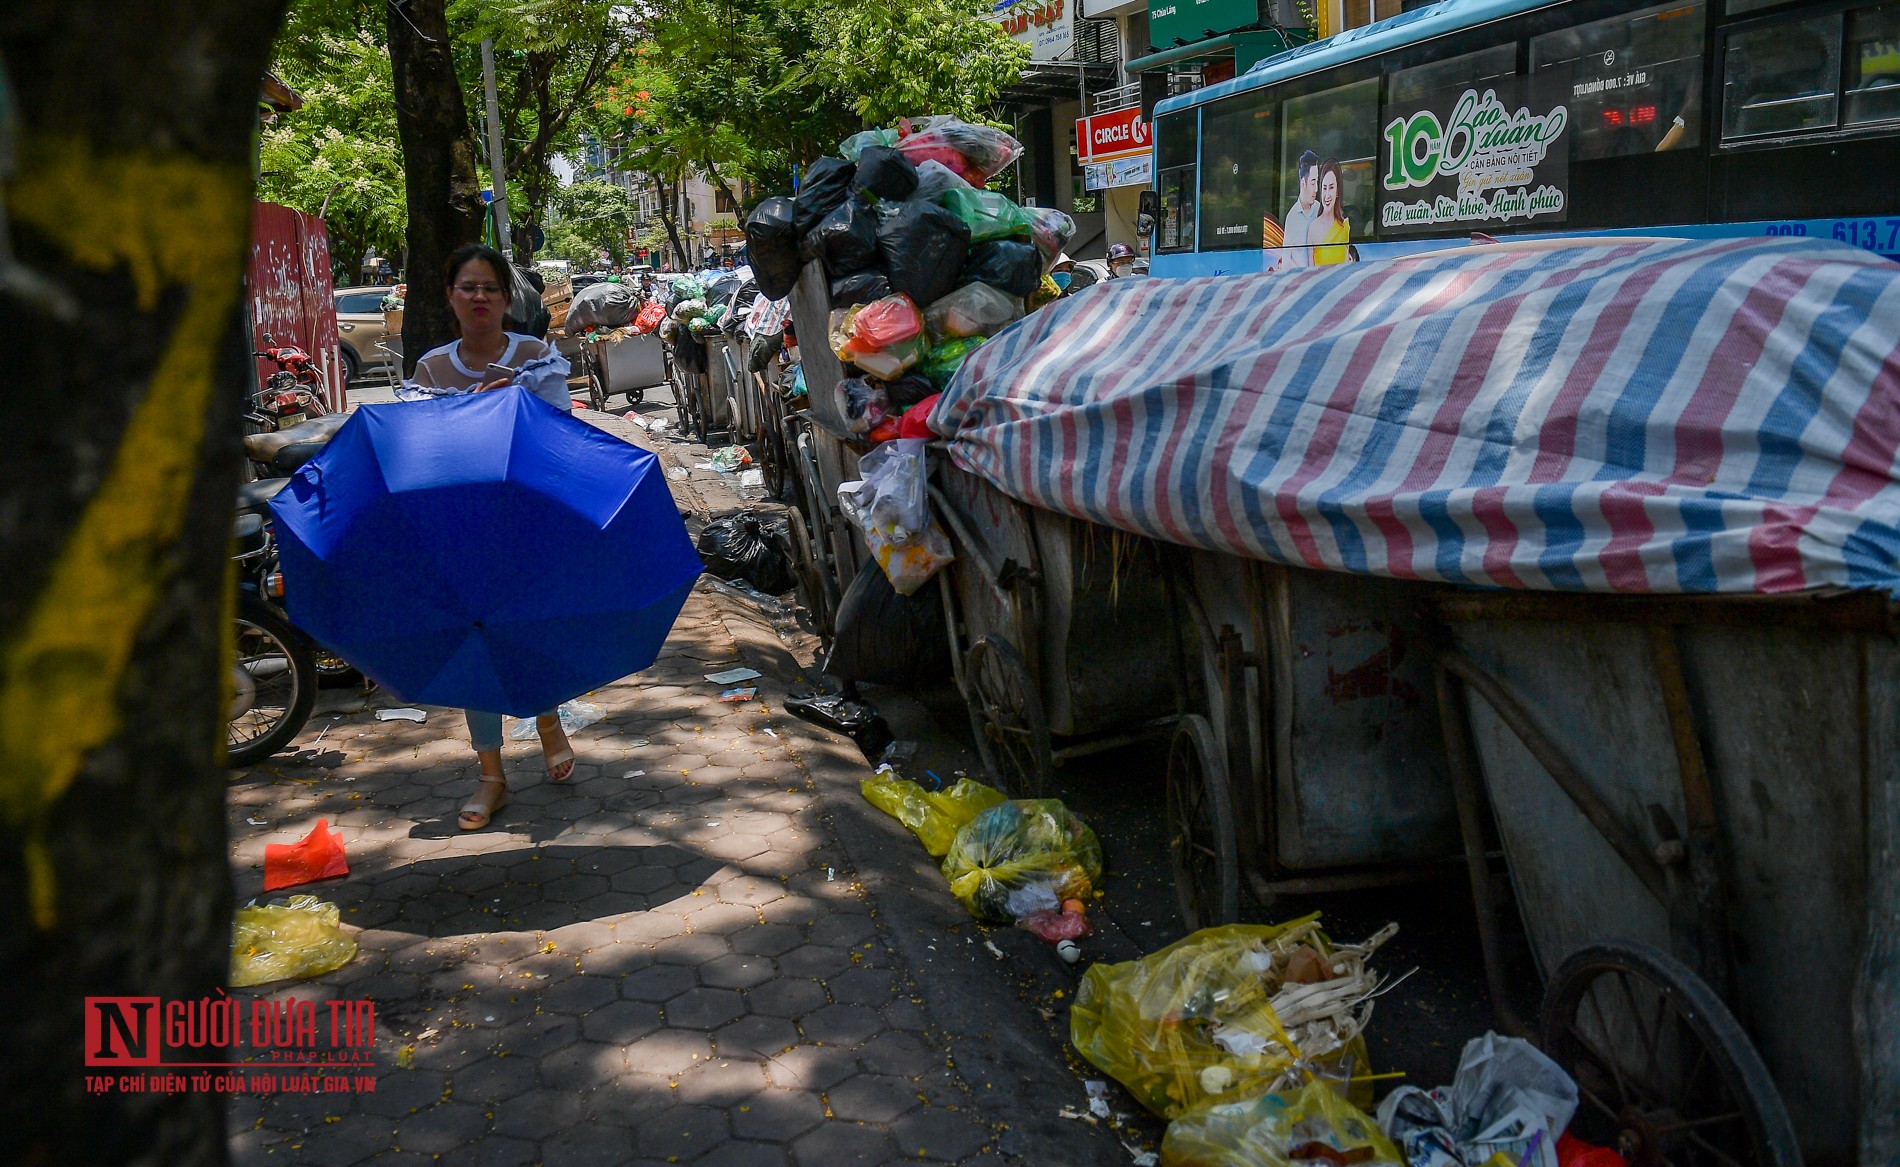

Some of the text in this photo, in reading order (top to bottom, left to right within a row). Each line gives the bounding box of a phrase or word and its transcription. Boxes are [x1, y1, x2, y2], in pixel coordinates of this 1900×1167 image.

[1094, 116, 1148, 145] CIRCLE K
[1479, 112, 1564, 155] xuân
[1386, 115, 1440, 185] 10
[1470, 149, 1538, 170] CÂN BẰNG NỘI TIẾT
[1384, 203, 1402, 223] Nét
[1405, 204, 1433, 221] xuân,
[1435, 199, 1455, 219] Sức
[1492, 191, 1526, 217] Hạnh
[1529, 190, 1561, 214] phúc
